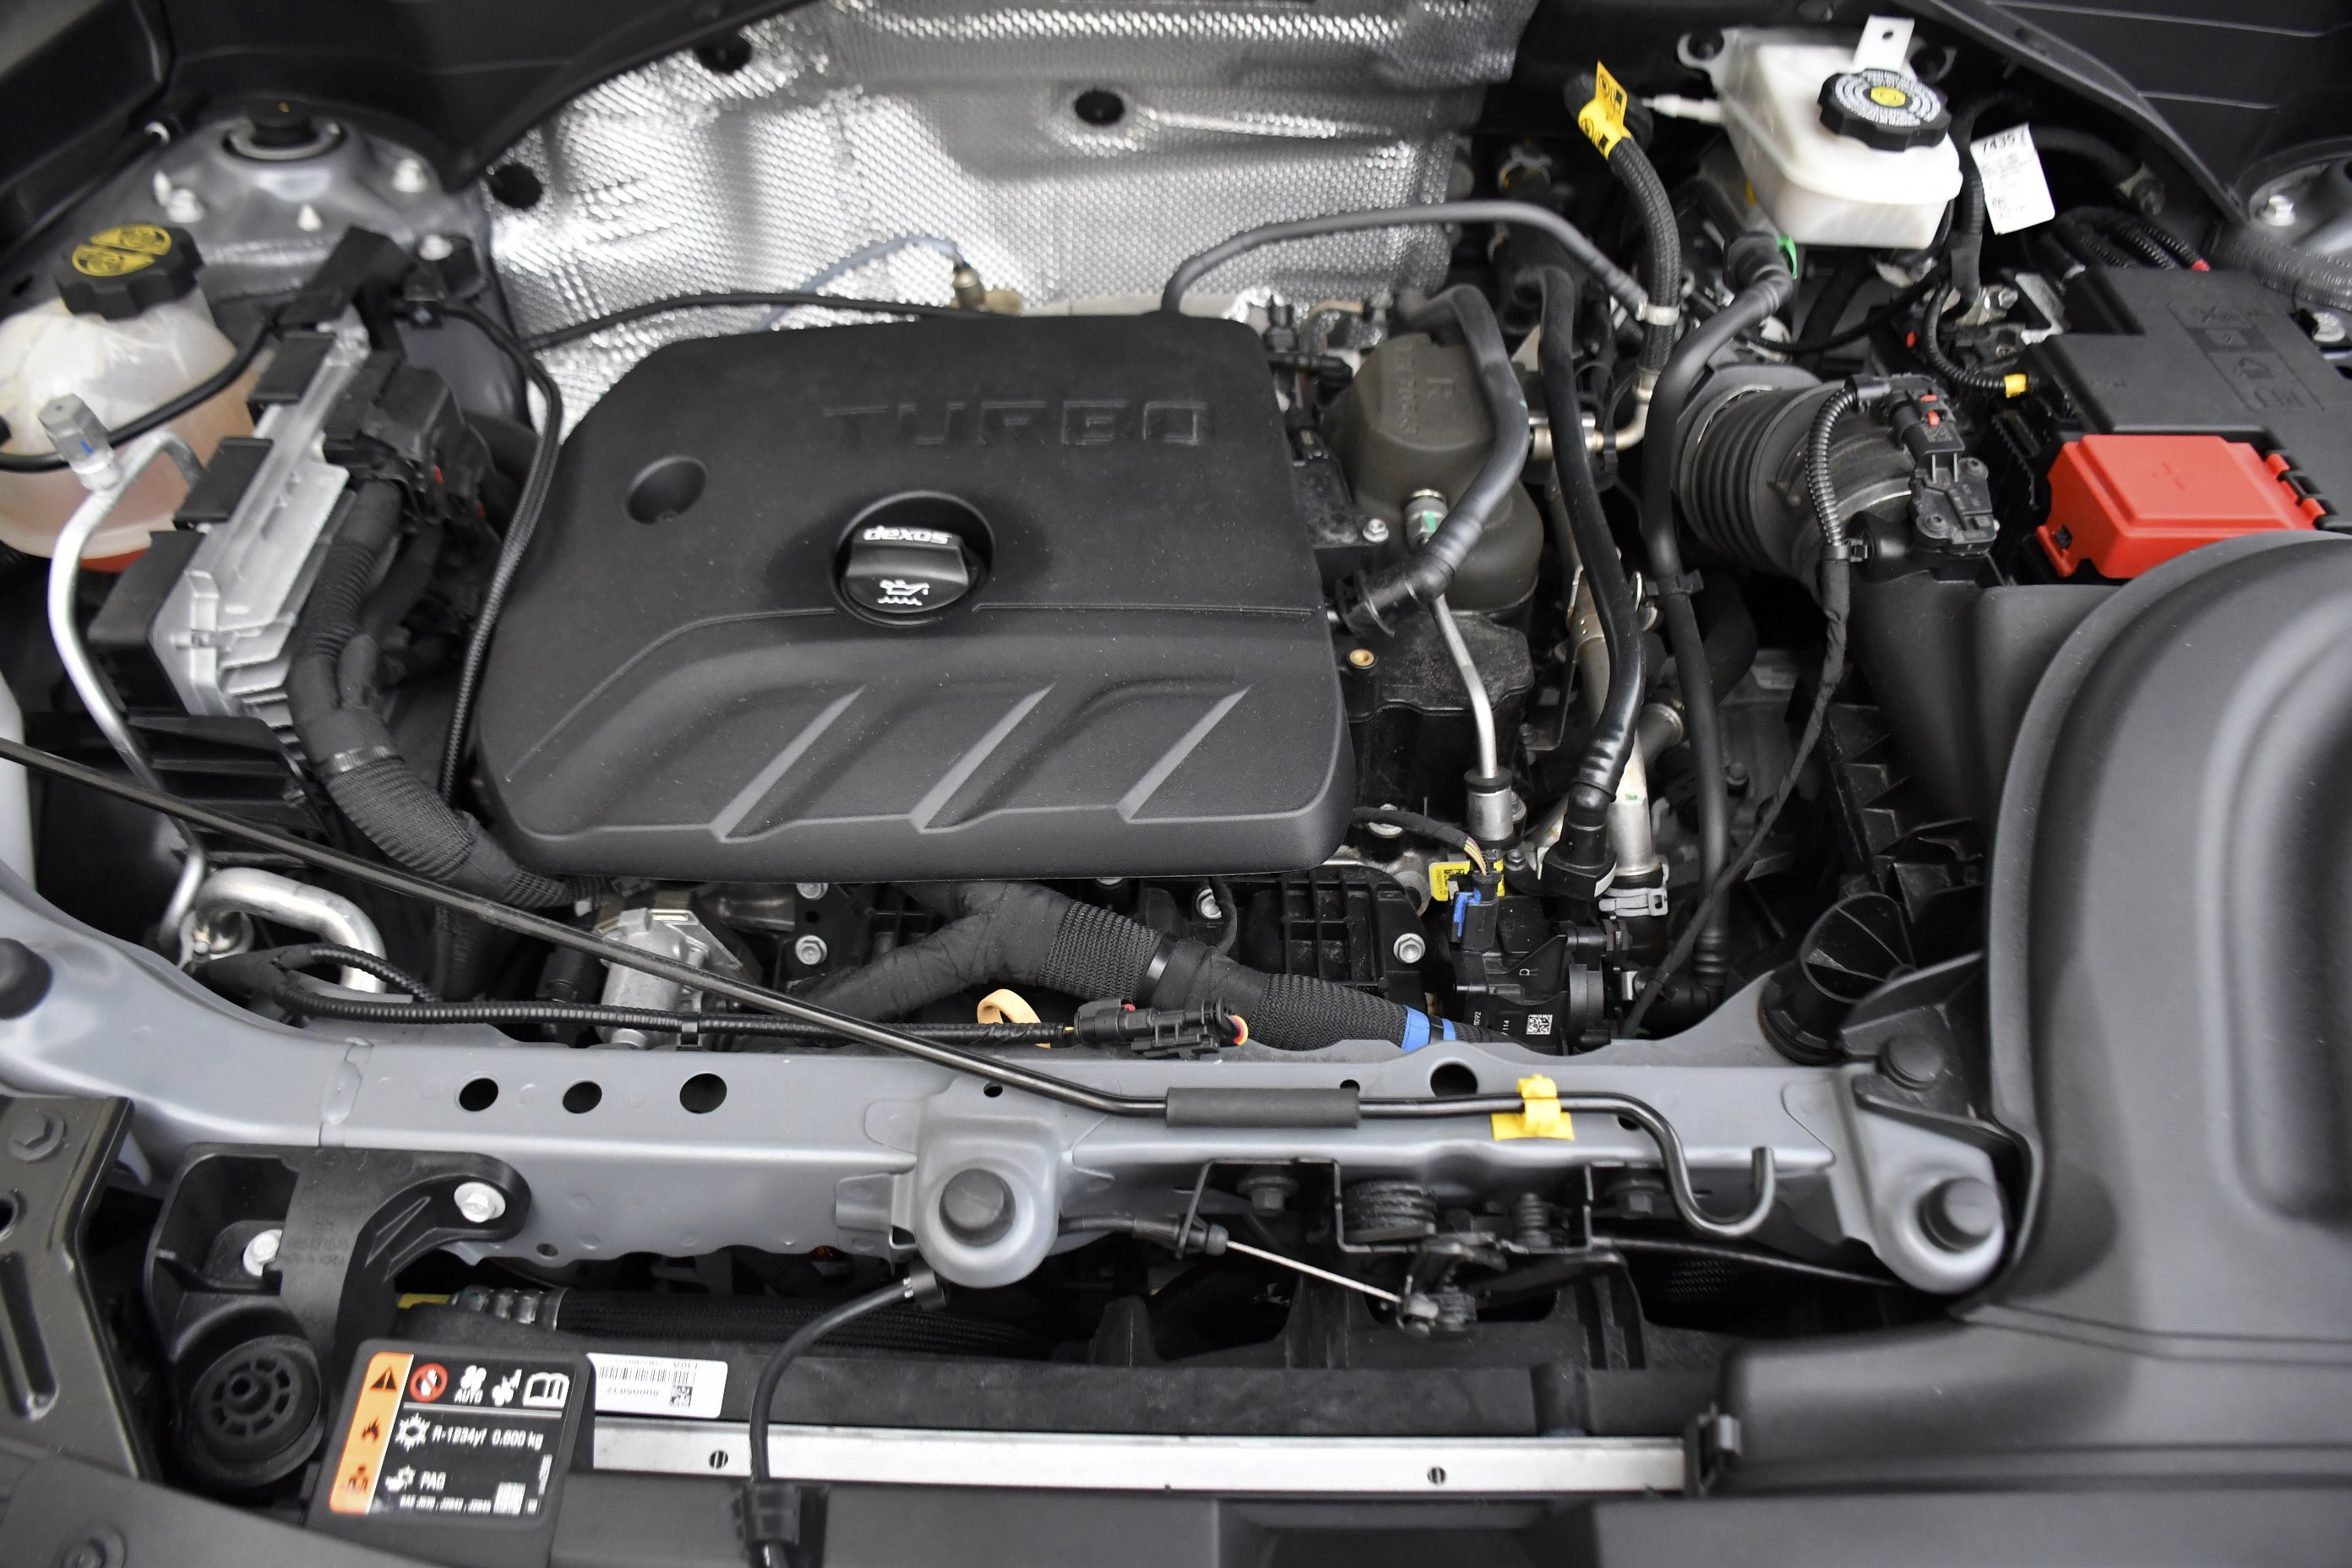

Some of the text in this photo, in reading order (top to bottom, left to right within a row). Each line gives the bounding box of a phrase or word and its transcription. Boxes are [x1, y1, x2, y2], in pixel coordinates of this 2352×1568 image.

[822, 400, 1208, 446] TURBO
[863, 525, 953, 545] dexos
[454, 1388, 484, 1405] AUTO
